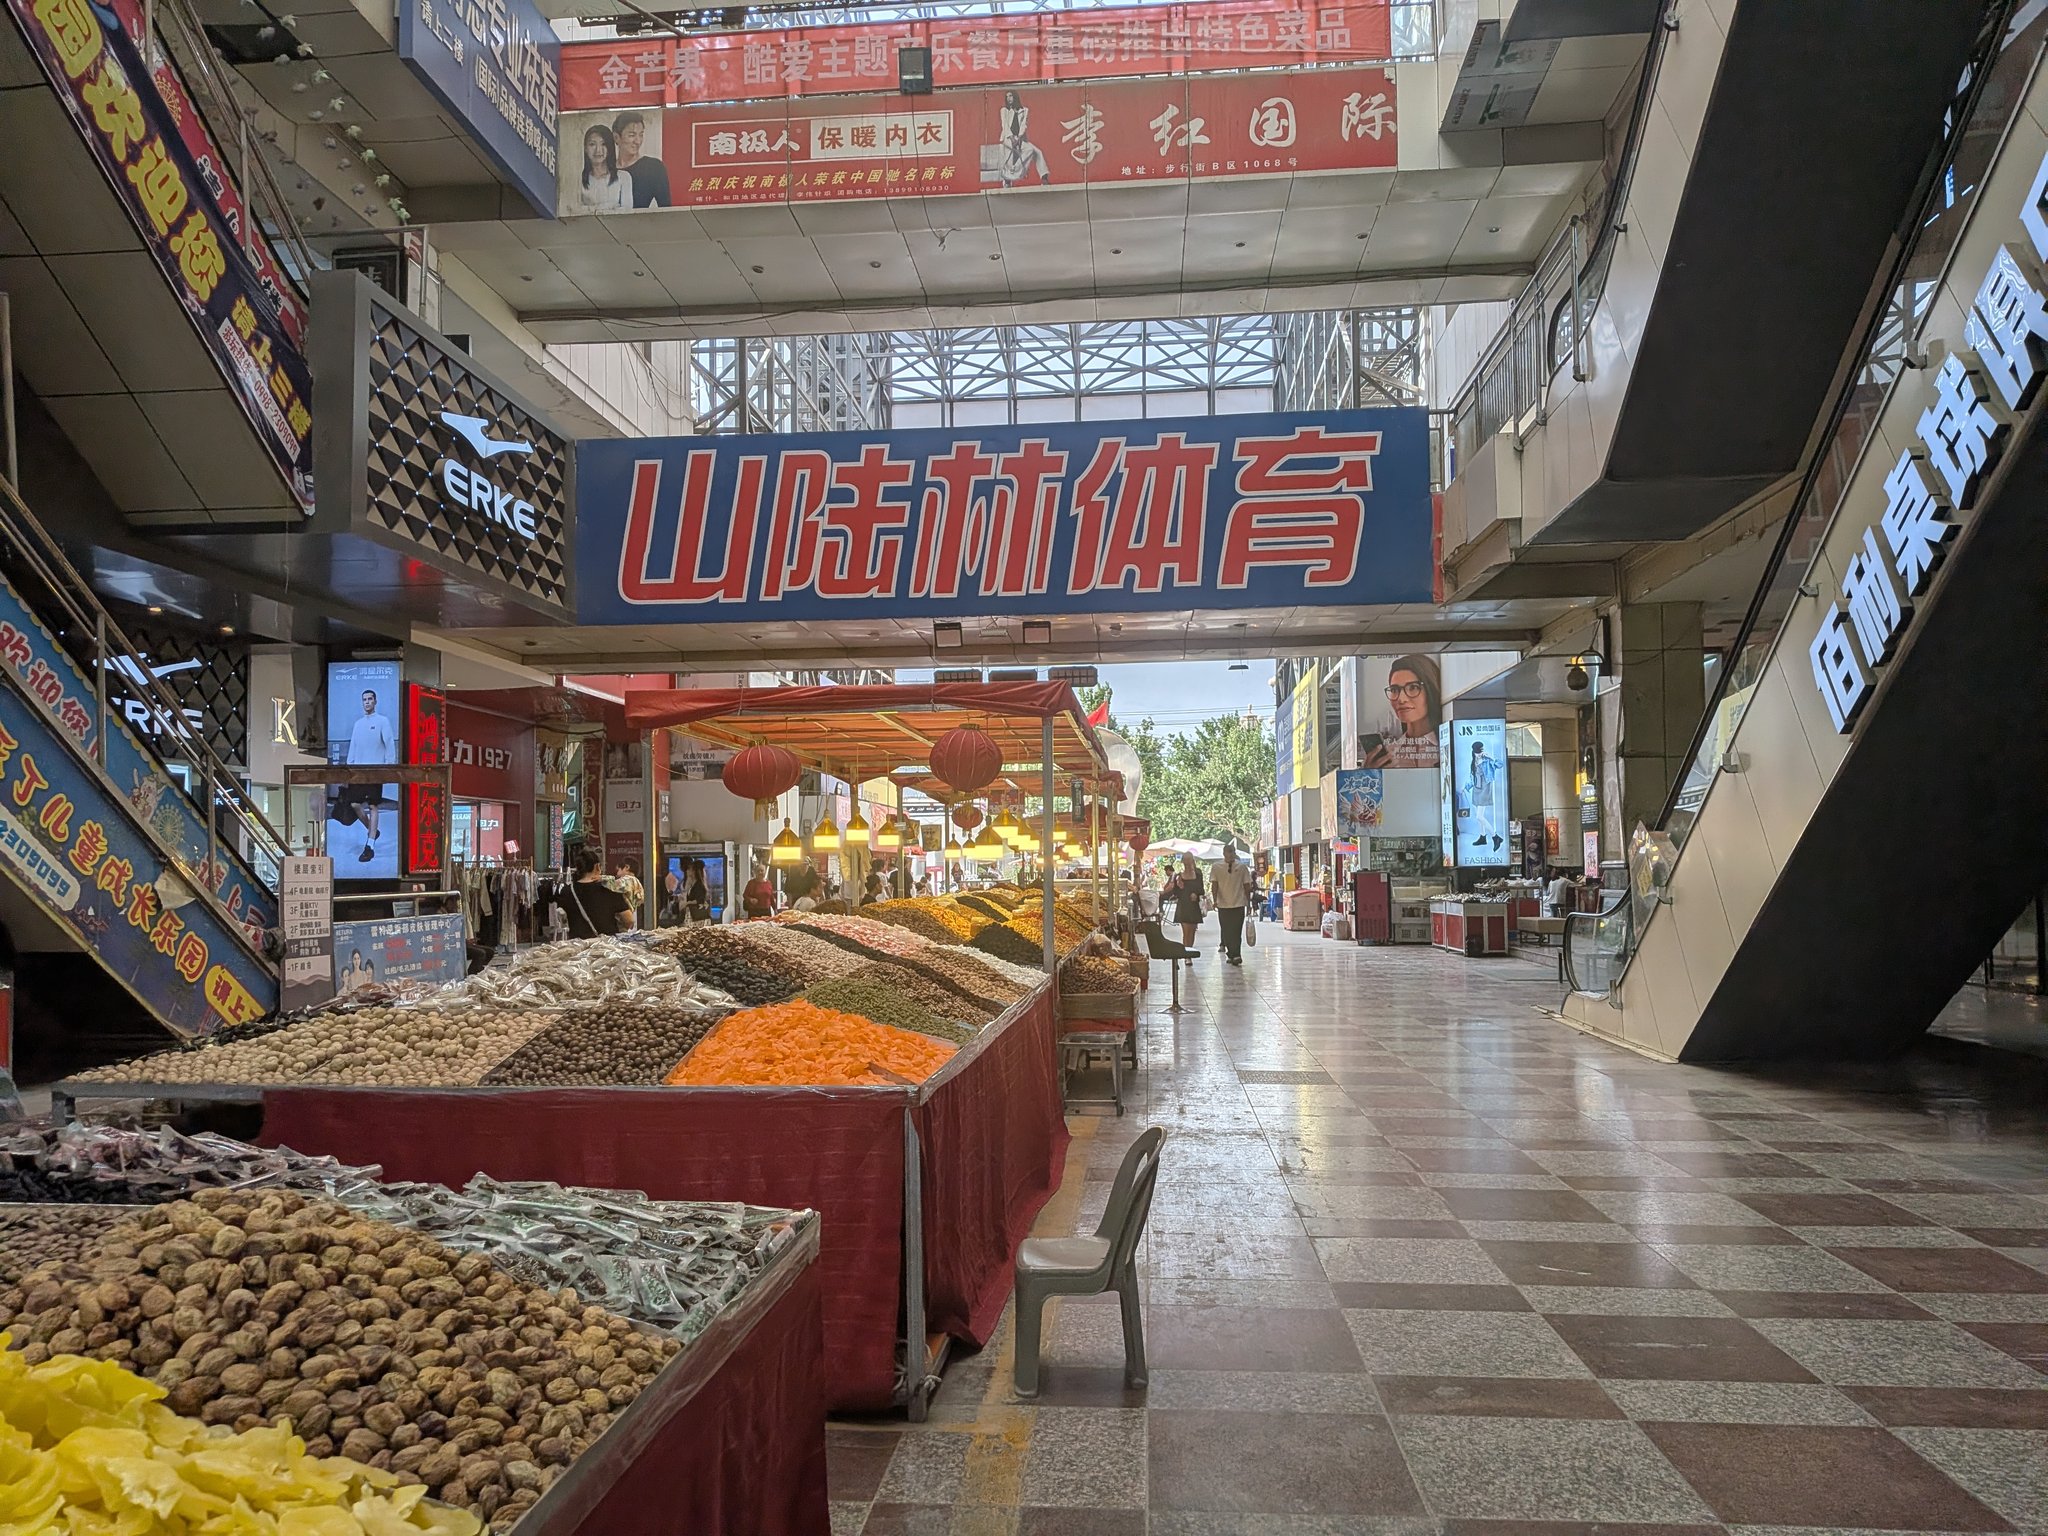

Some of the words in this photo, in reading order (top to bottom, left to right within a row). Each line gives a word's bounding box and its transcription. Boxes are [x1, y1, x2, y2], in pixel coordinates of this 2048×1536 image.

[447, 0, 558, 137] 恩专业祛痘
[708, 130, 801, 156] 南极人
[818, 121, 943, 151] 保暖内衣
[231, 293, 312, 440] 请上三楼
[443, 458, 536, 541] ERKE
[271, 697, 298, 746] K
[478, 745, 513, 770] 1927
[1464, 857, 1504, 865] FASHION
[290, 945, 299, 953] 1F
